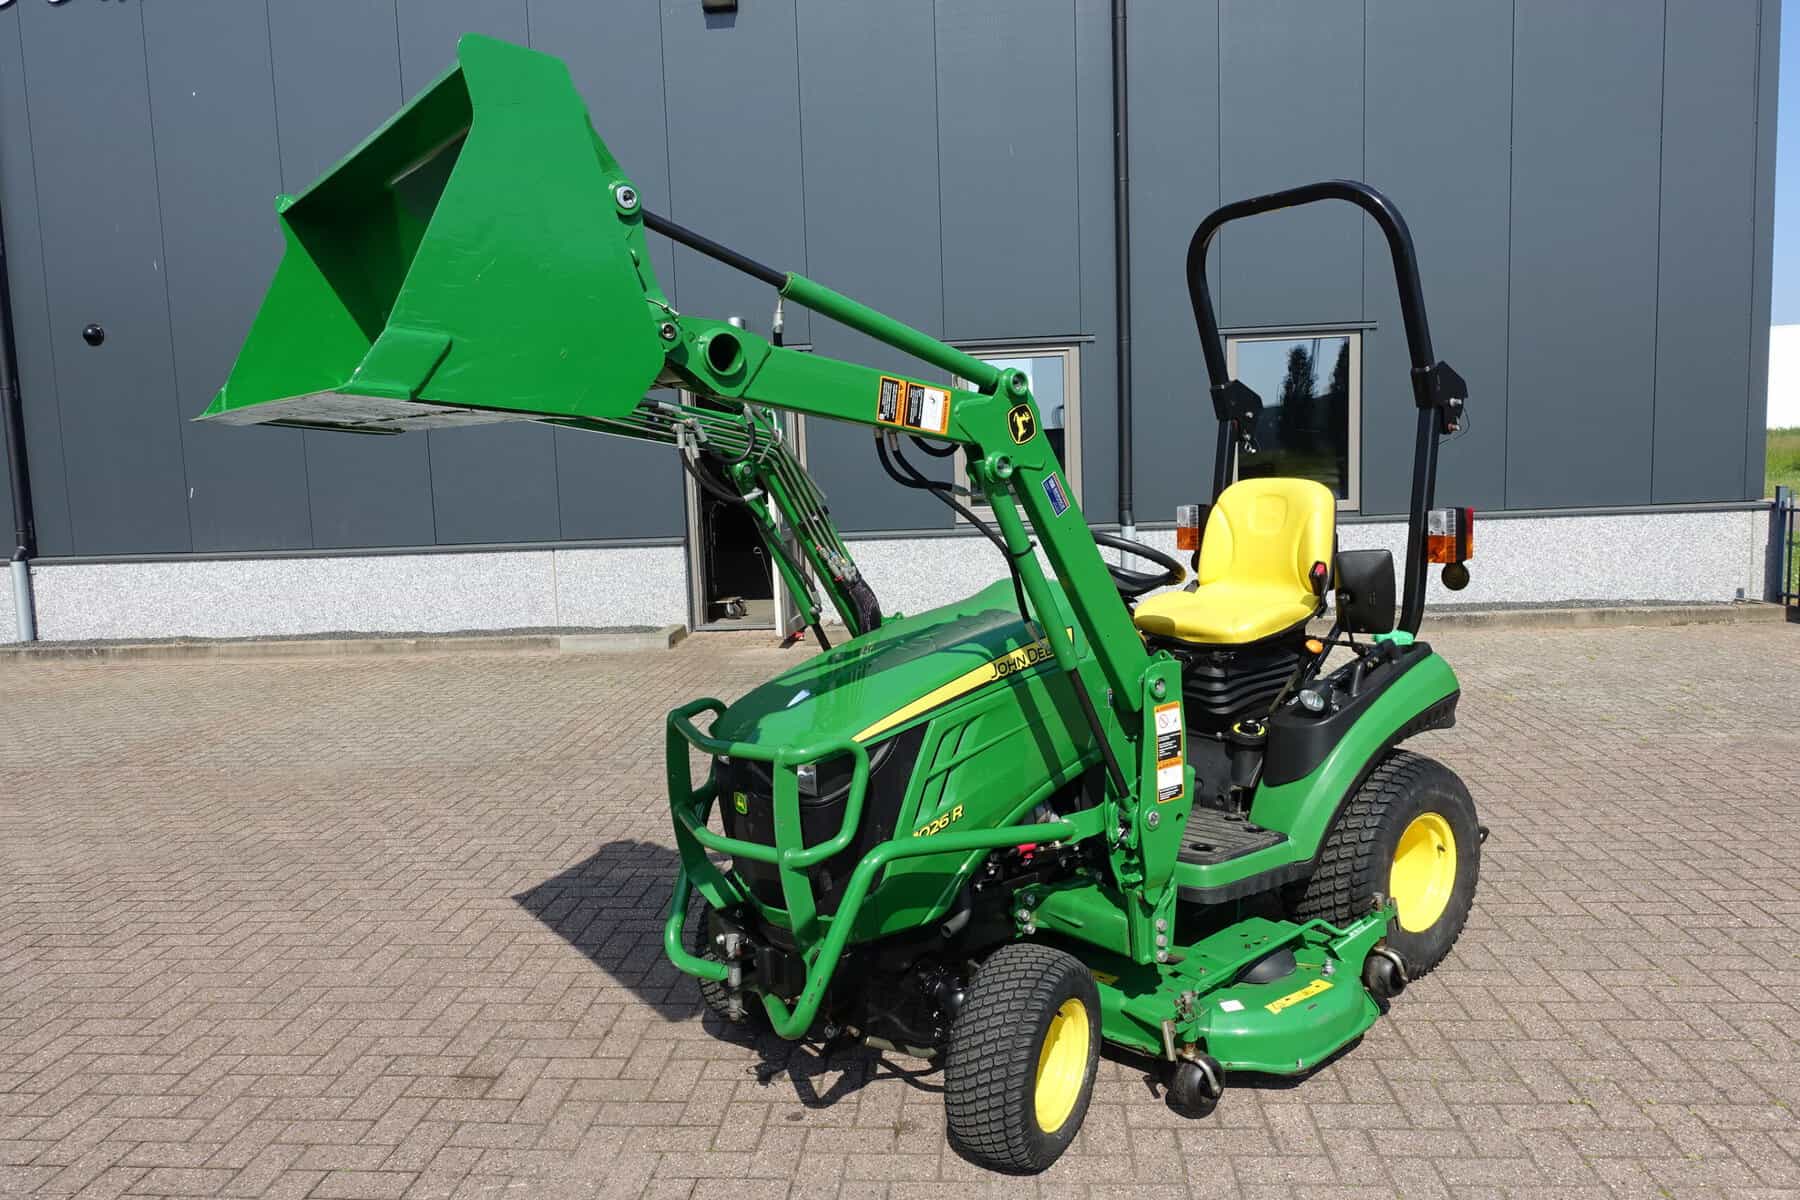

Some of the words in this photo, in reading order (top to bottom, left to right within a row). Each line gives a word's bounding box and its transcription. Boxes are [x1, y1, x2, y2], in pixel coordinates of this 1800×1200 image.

[992, 654, 1026, 678] JOHN
[913, 812, 950, 837] 026
[952, 804, 964, 822] R
